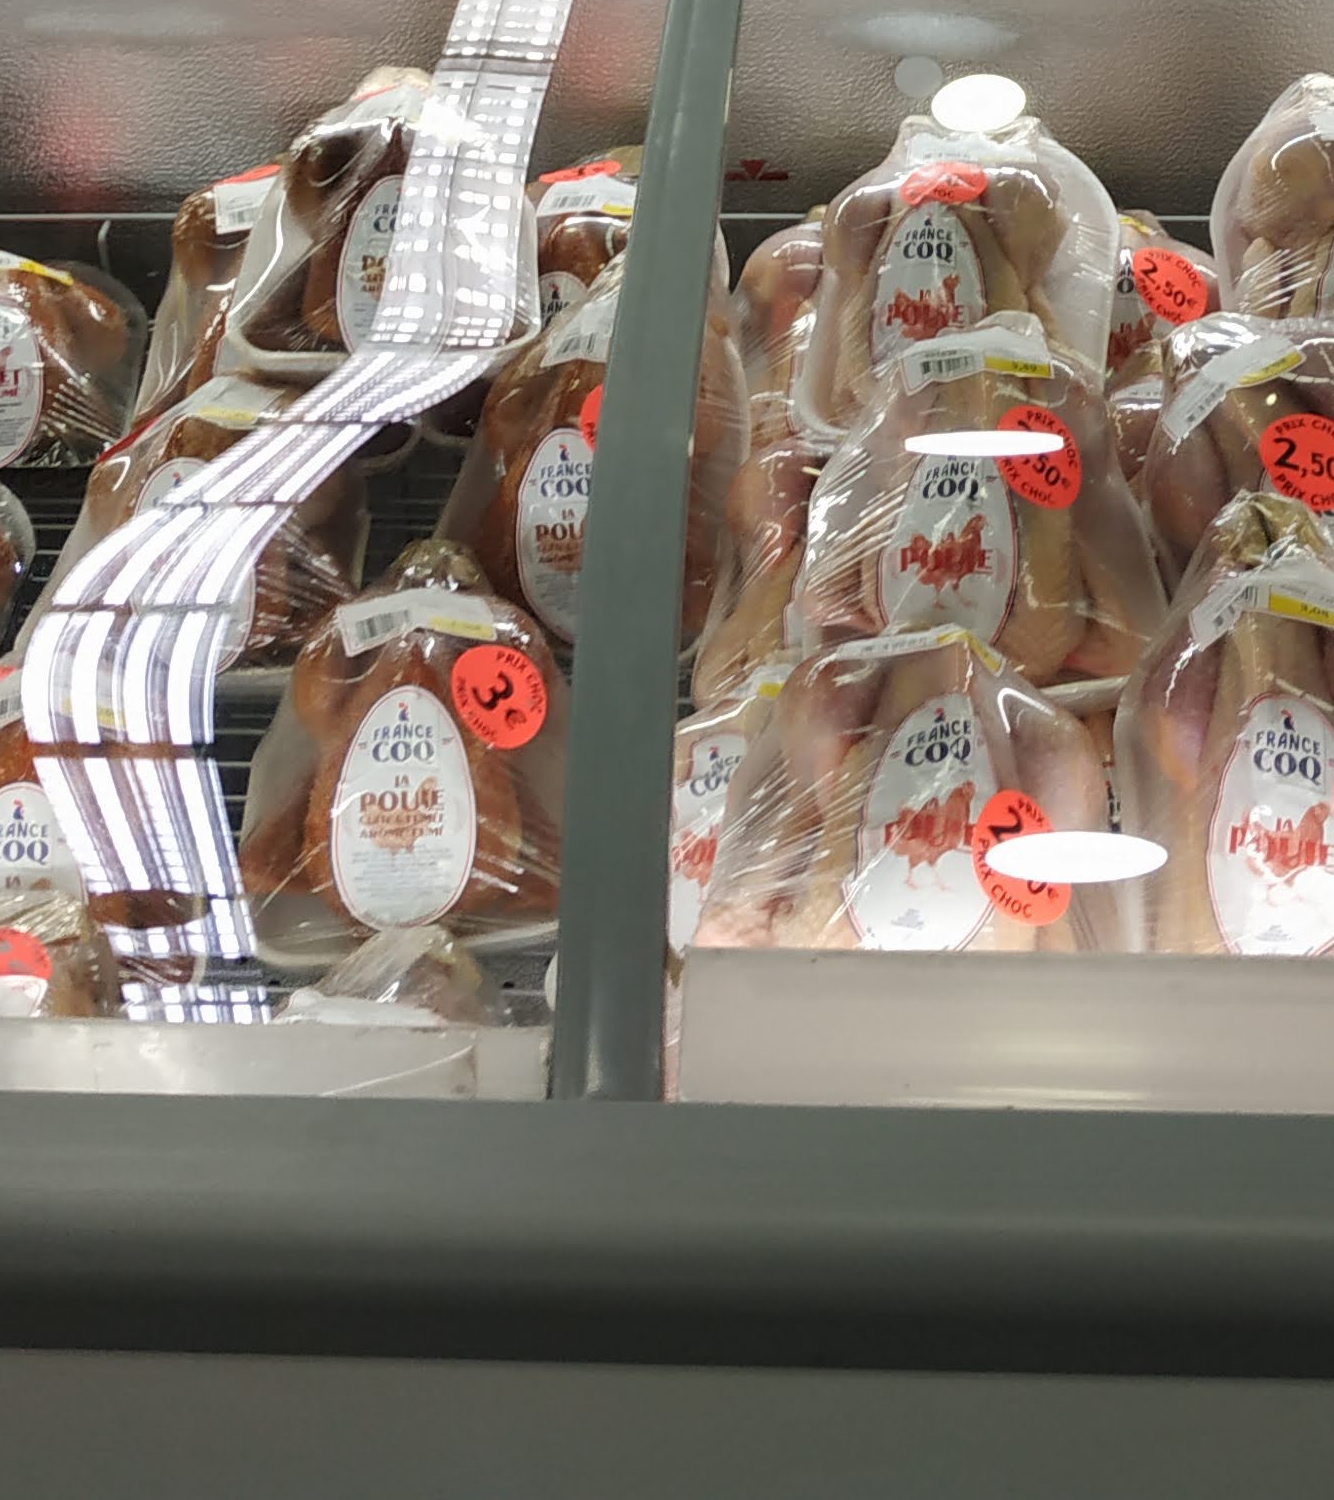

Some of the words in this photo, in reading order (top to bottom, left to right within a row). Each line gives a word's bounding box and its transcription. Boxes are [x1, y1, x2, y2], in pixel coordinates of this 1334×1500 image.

[374, 216, 403, 234] CO
[906, 230, 953, 242] FRANCE
[903, 241, 955, 261] COQ
[1026, 410, 1056, 430] PRIX
[1275, 418, 1307, 435] PRIX
[539, 463, 591, 479] FRANCE
[923, 477, 979, 501] COQ
[1275, 473, 1306, 499] PRIX
[535, 522, 585, 544] POU
[495, 651, 526, 675] PRIX
[373, 723, 434, 739] FRANCE
[907, 718, 973, 748] FRANCE
[1255, 730, 1322, 756] FRANCE
[372, 740, 435, 764] COQ
[904, 738, 972, 767] COQ
[1253, 748, 1323, 786] COQ
[1018, 798, 1047, 828] PRIX
[991, 884, 1033, 919] CHOC
